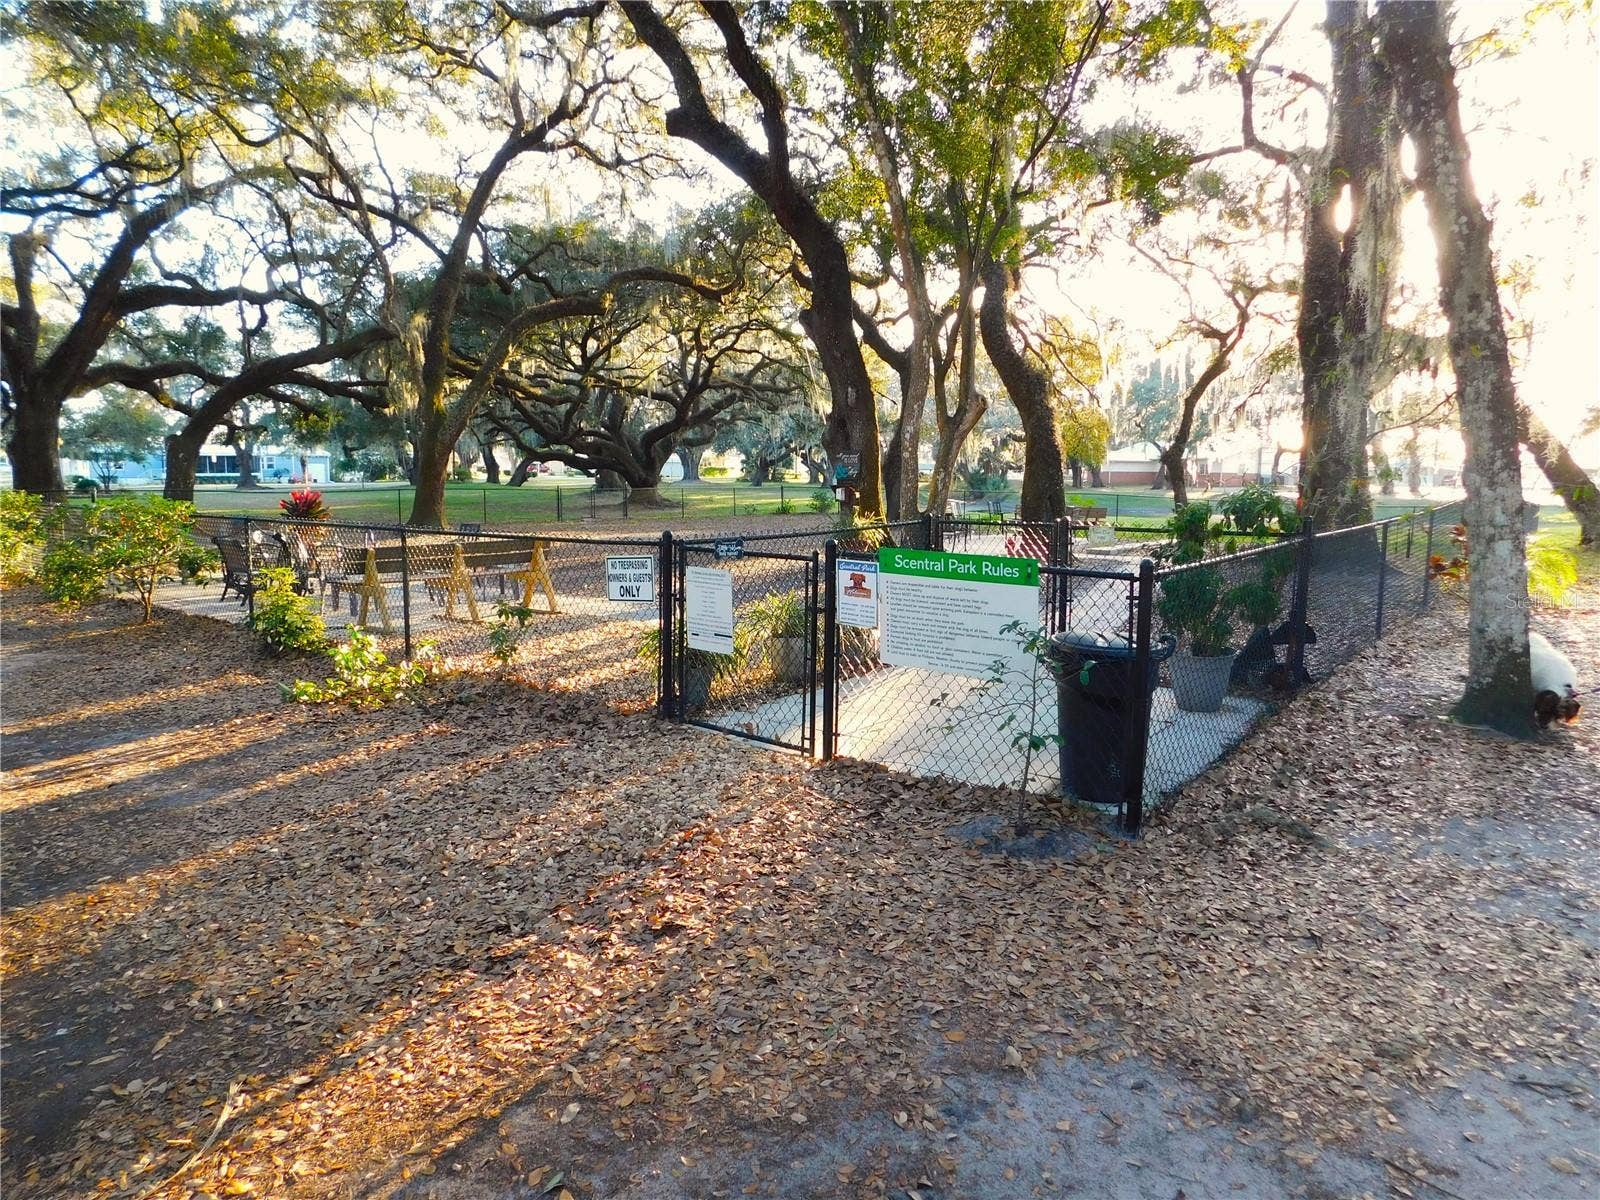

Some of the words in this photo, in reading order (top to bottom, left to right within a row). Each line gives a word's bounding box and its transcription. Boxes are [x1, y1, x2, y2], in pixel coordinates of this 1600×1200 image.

[610, 560, 617, 570] NO
[617, 560, 648, 570] TRESPASSING
[895, 555, 944, 572] Scentral
[948, 560, 977, 575] Park
[982, 562, 1020, 578] Rules
[609, 573, 628, 583] OWNERS
[632, 573, 652, 583] GUESTS
[619, 585, 641, 598] ONLY
